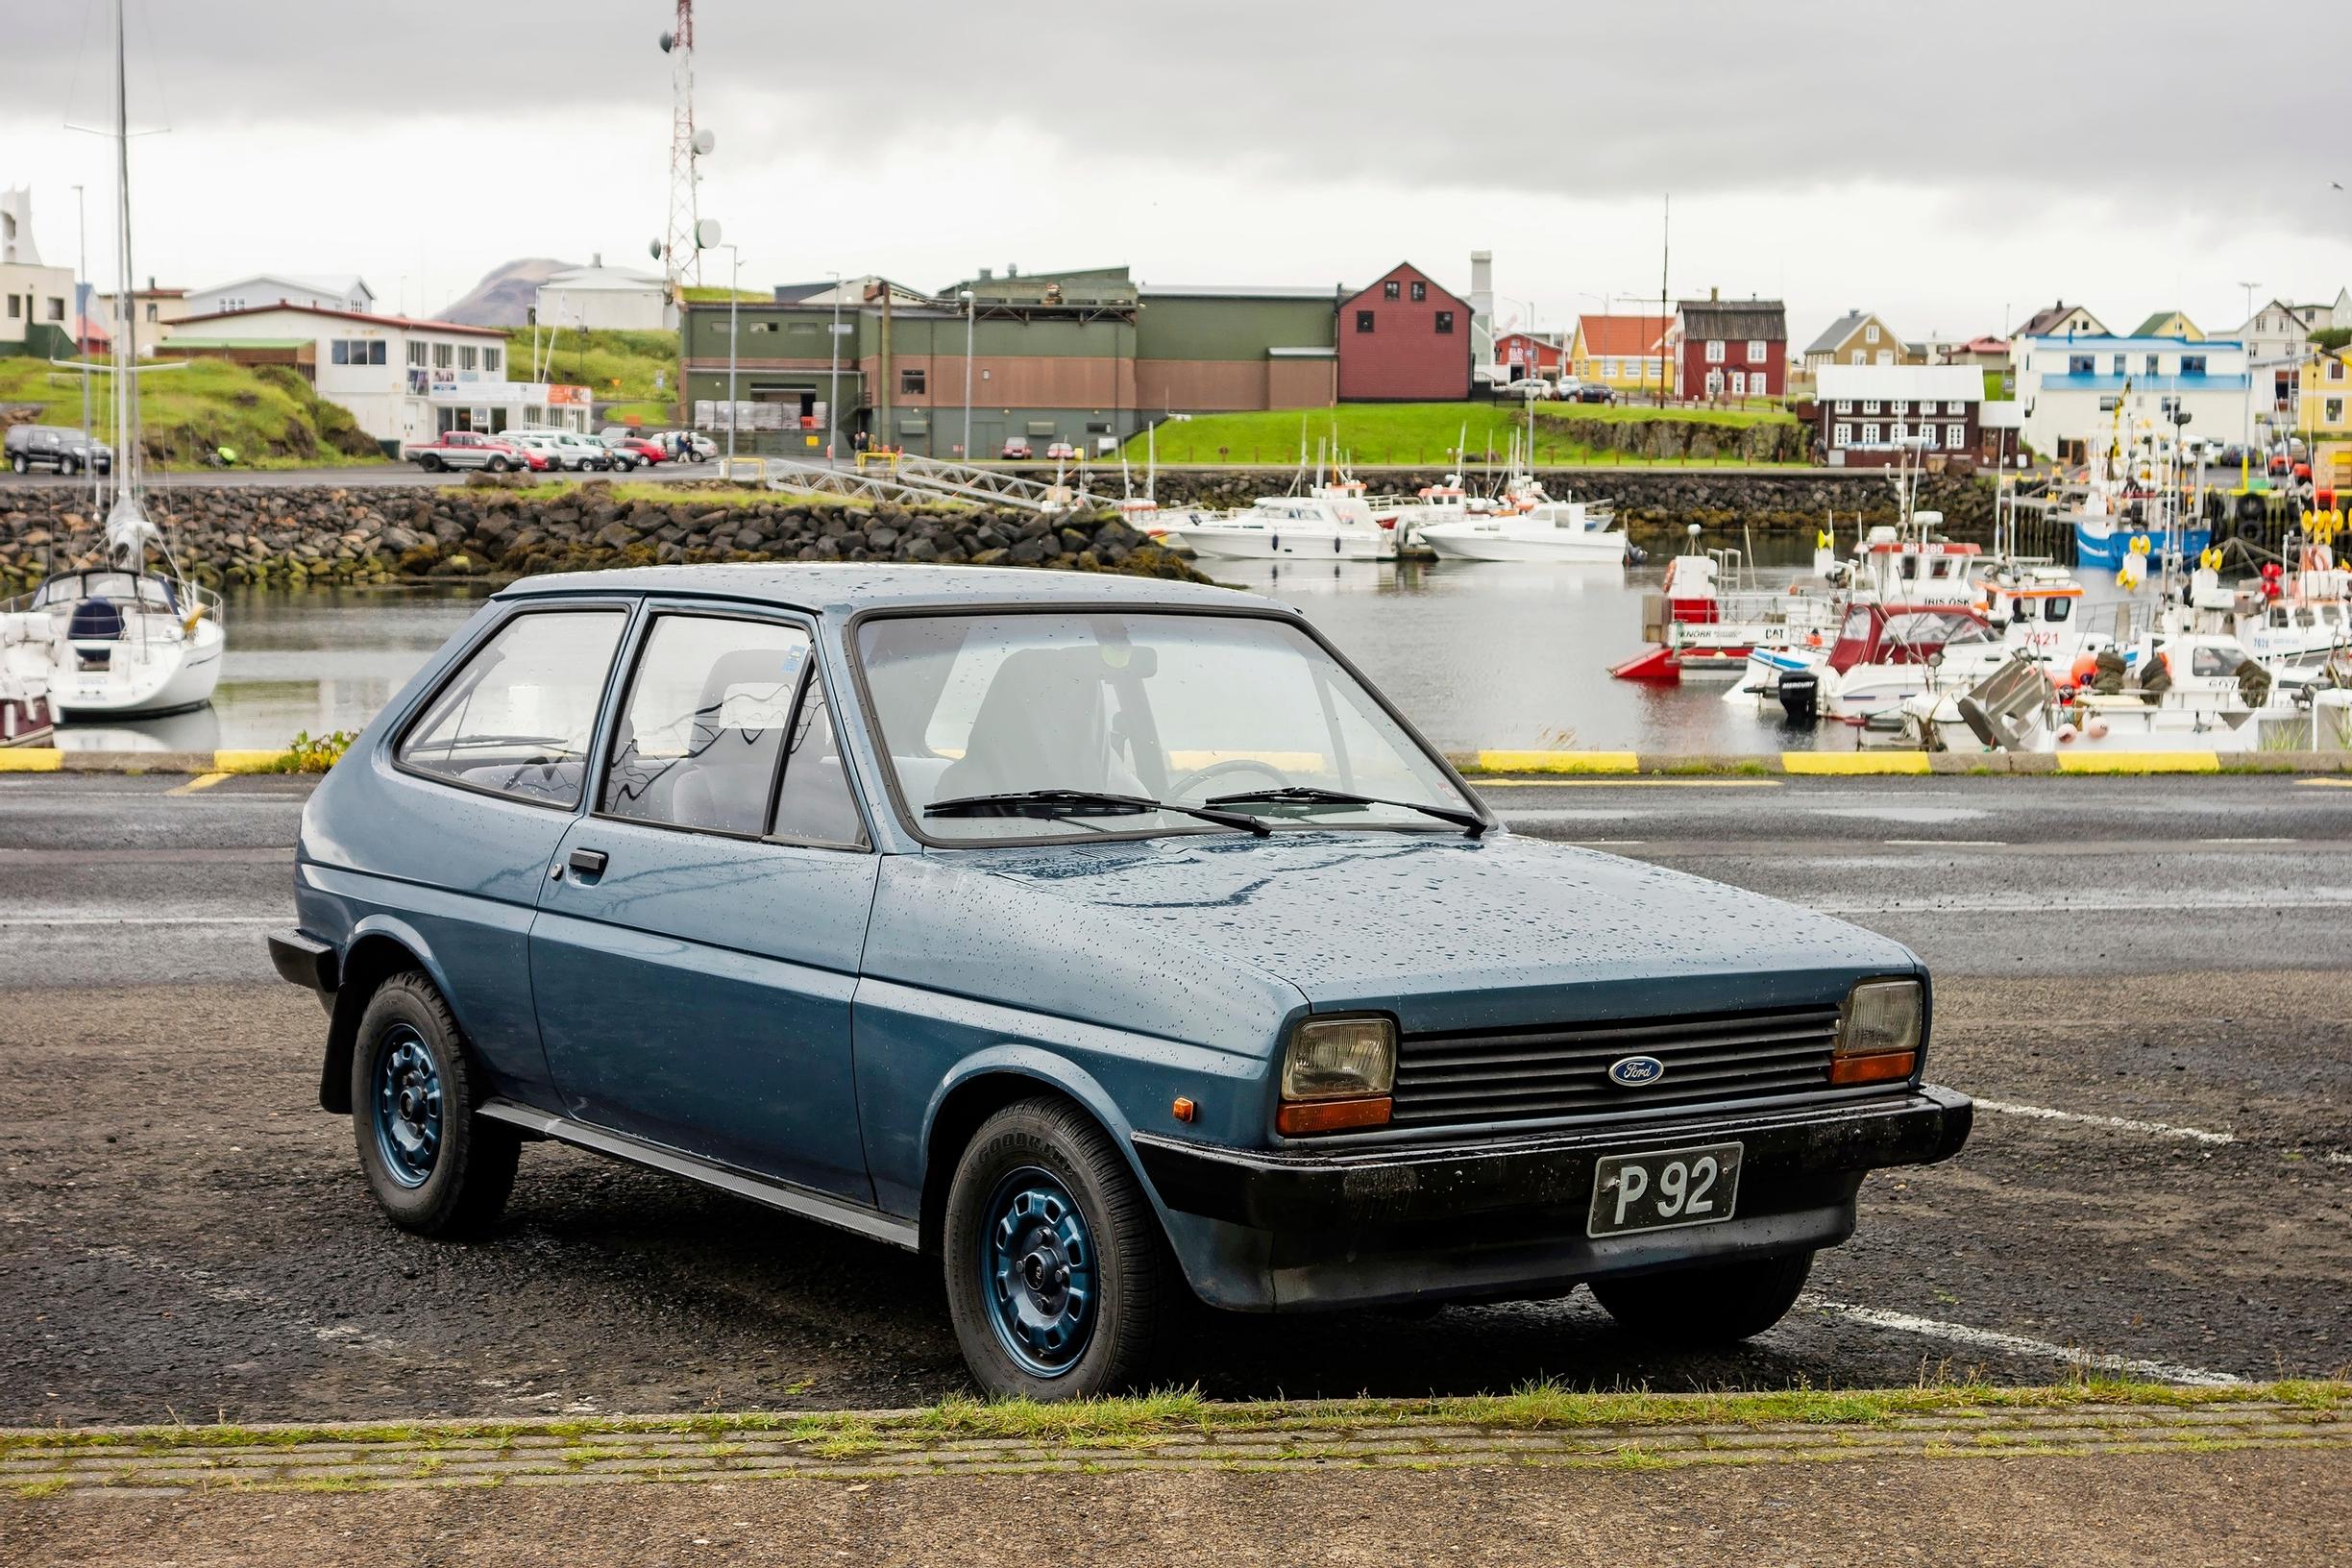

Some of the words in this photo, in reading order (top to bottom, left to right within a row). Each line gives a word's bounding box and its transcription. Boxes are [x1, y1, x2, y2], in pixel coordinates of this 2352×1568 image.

[1902, 543, 1919, 553] SH
[1782, 681, 1815, 690] MERCURY
[1623, 1061, 1653, 1079] Ford
[1614, 1164, 1649, 1225] P
[1656, 1156, 1718, 1218] 92
